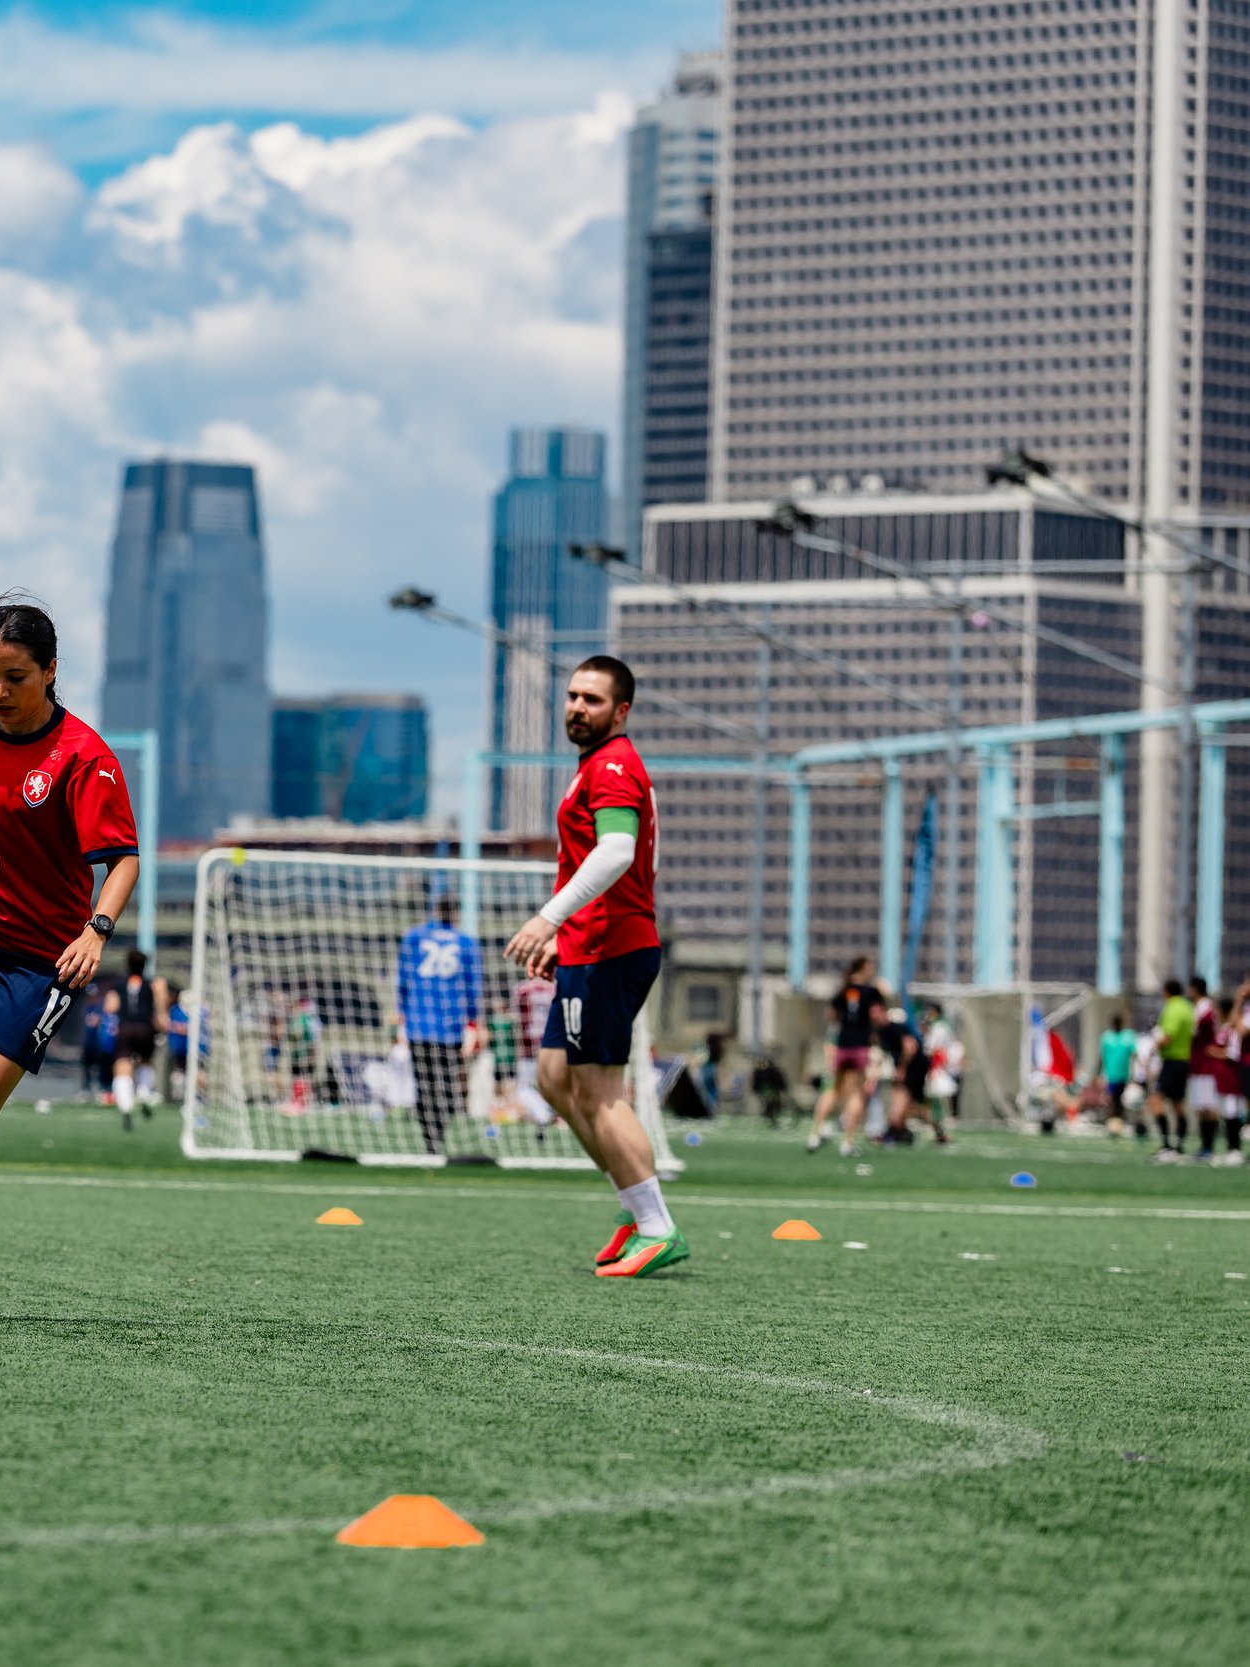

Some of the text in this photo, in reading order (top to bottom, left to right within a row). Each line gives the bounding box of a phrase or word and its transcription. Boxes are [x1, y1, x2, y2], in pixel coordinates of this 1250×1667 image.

[417, 939, 461, 979] 26
[36, 987, 72, 1037] 12
[561, 997, 583, 1035] 10
